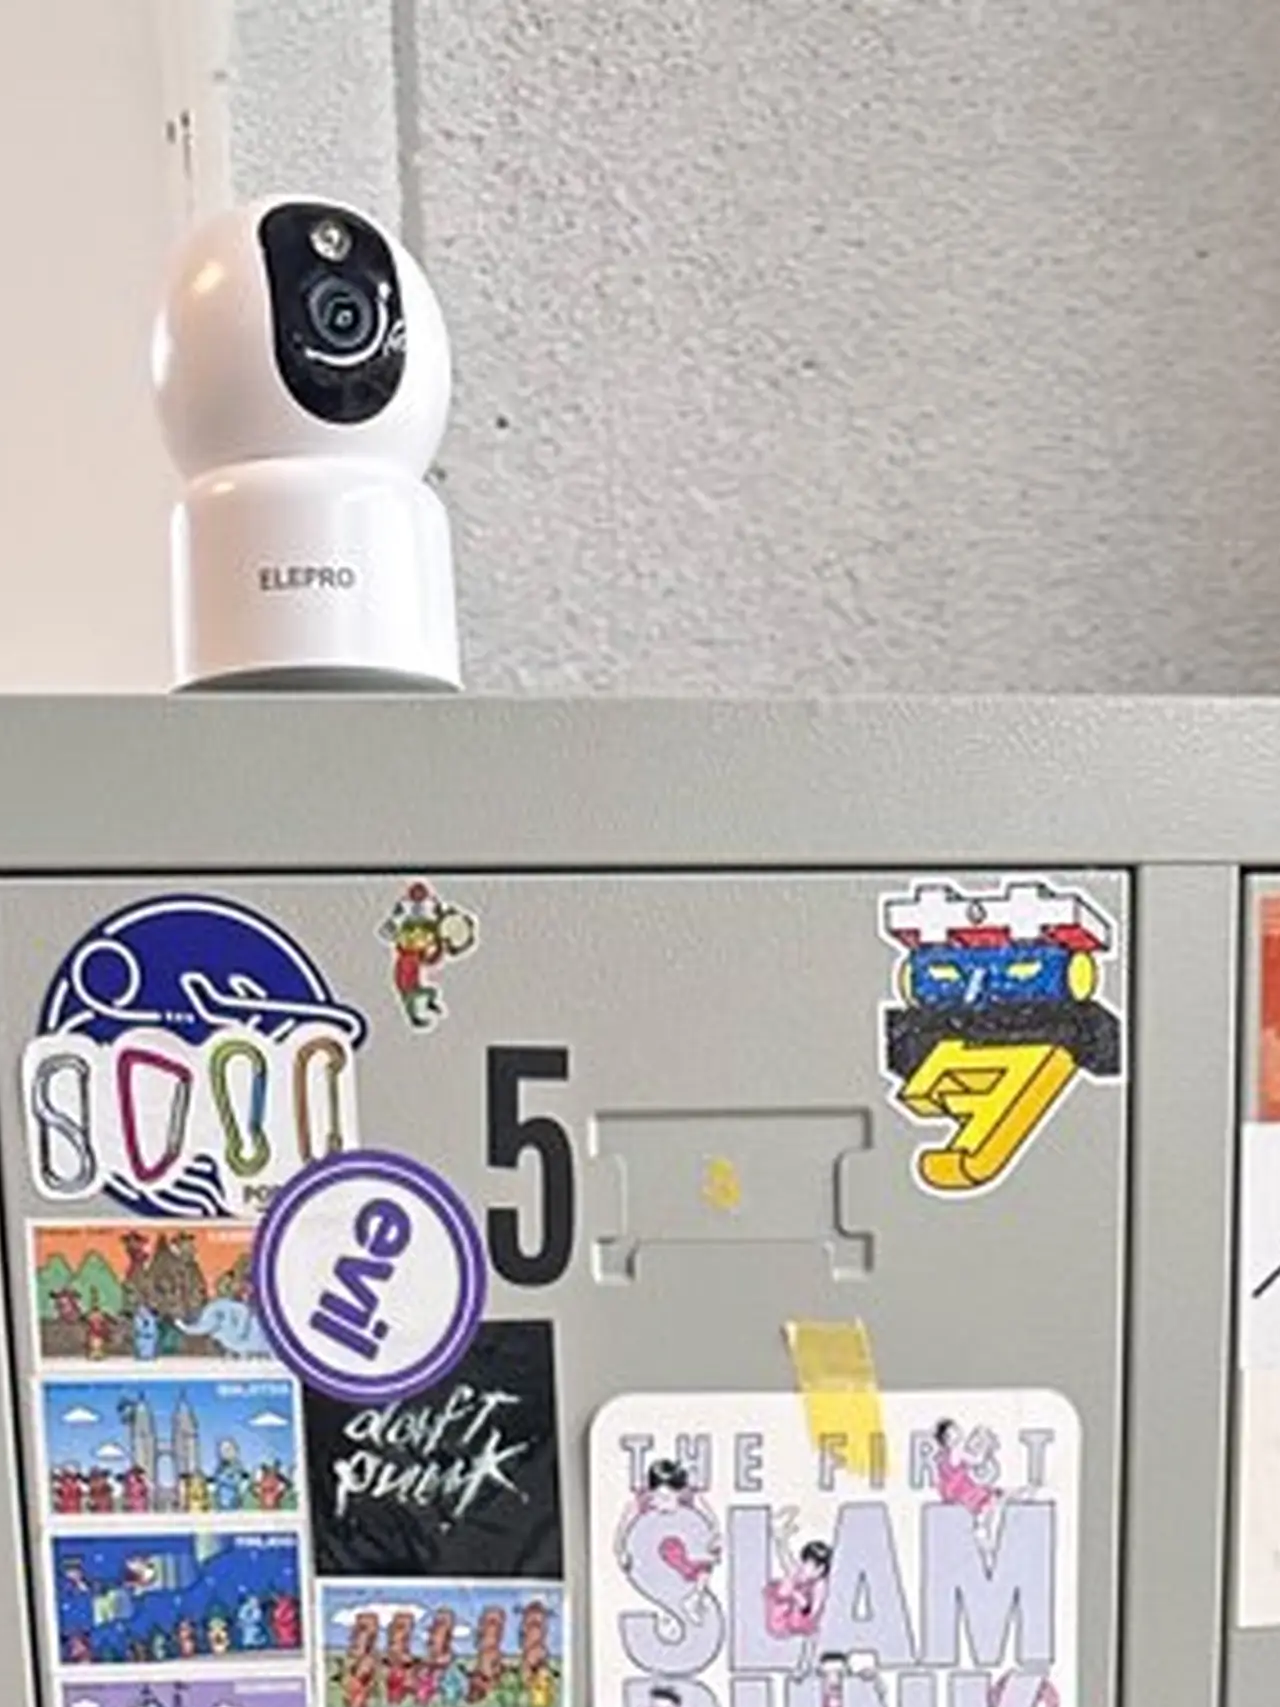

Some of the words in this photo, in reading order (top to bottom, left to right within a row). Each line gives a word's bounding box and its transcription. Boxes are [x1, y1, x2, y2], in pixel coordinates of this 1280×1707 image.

[260, 566, 356, 592] ELEPRO
[486, 1046, 575, 1287] 5
[310, 1198, 412, 1361] evil
[332, 1428, 532, 1518] punk
[621, 1431, 764, 1493] THE
[818, 1427, 1055, 1493] FIRST
[620, 1501, 1056, 1676] SLAM
